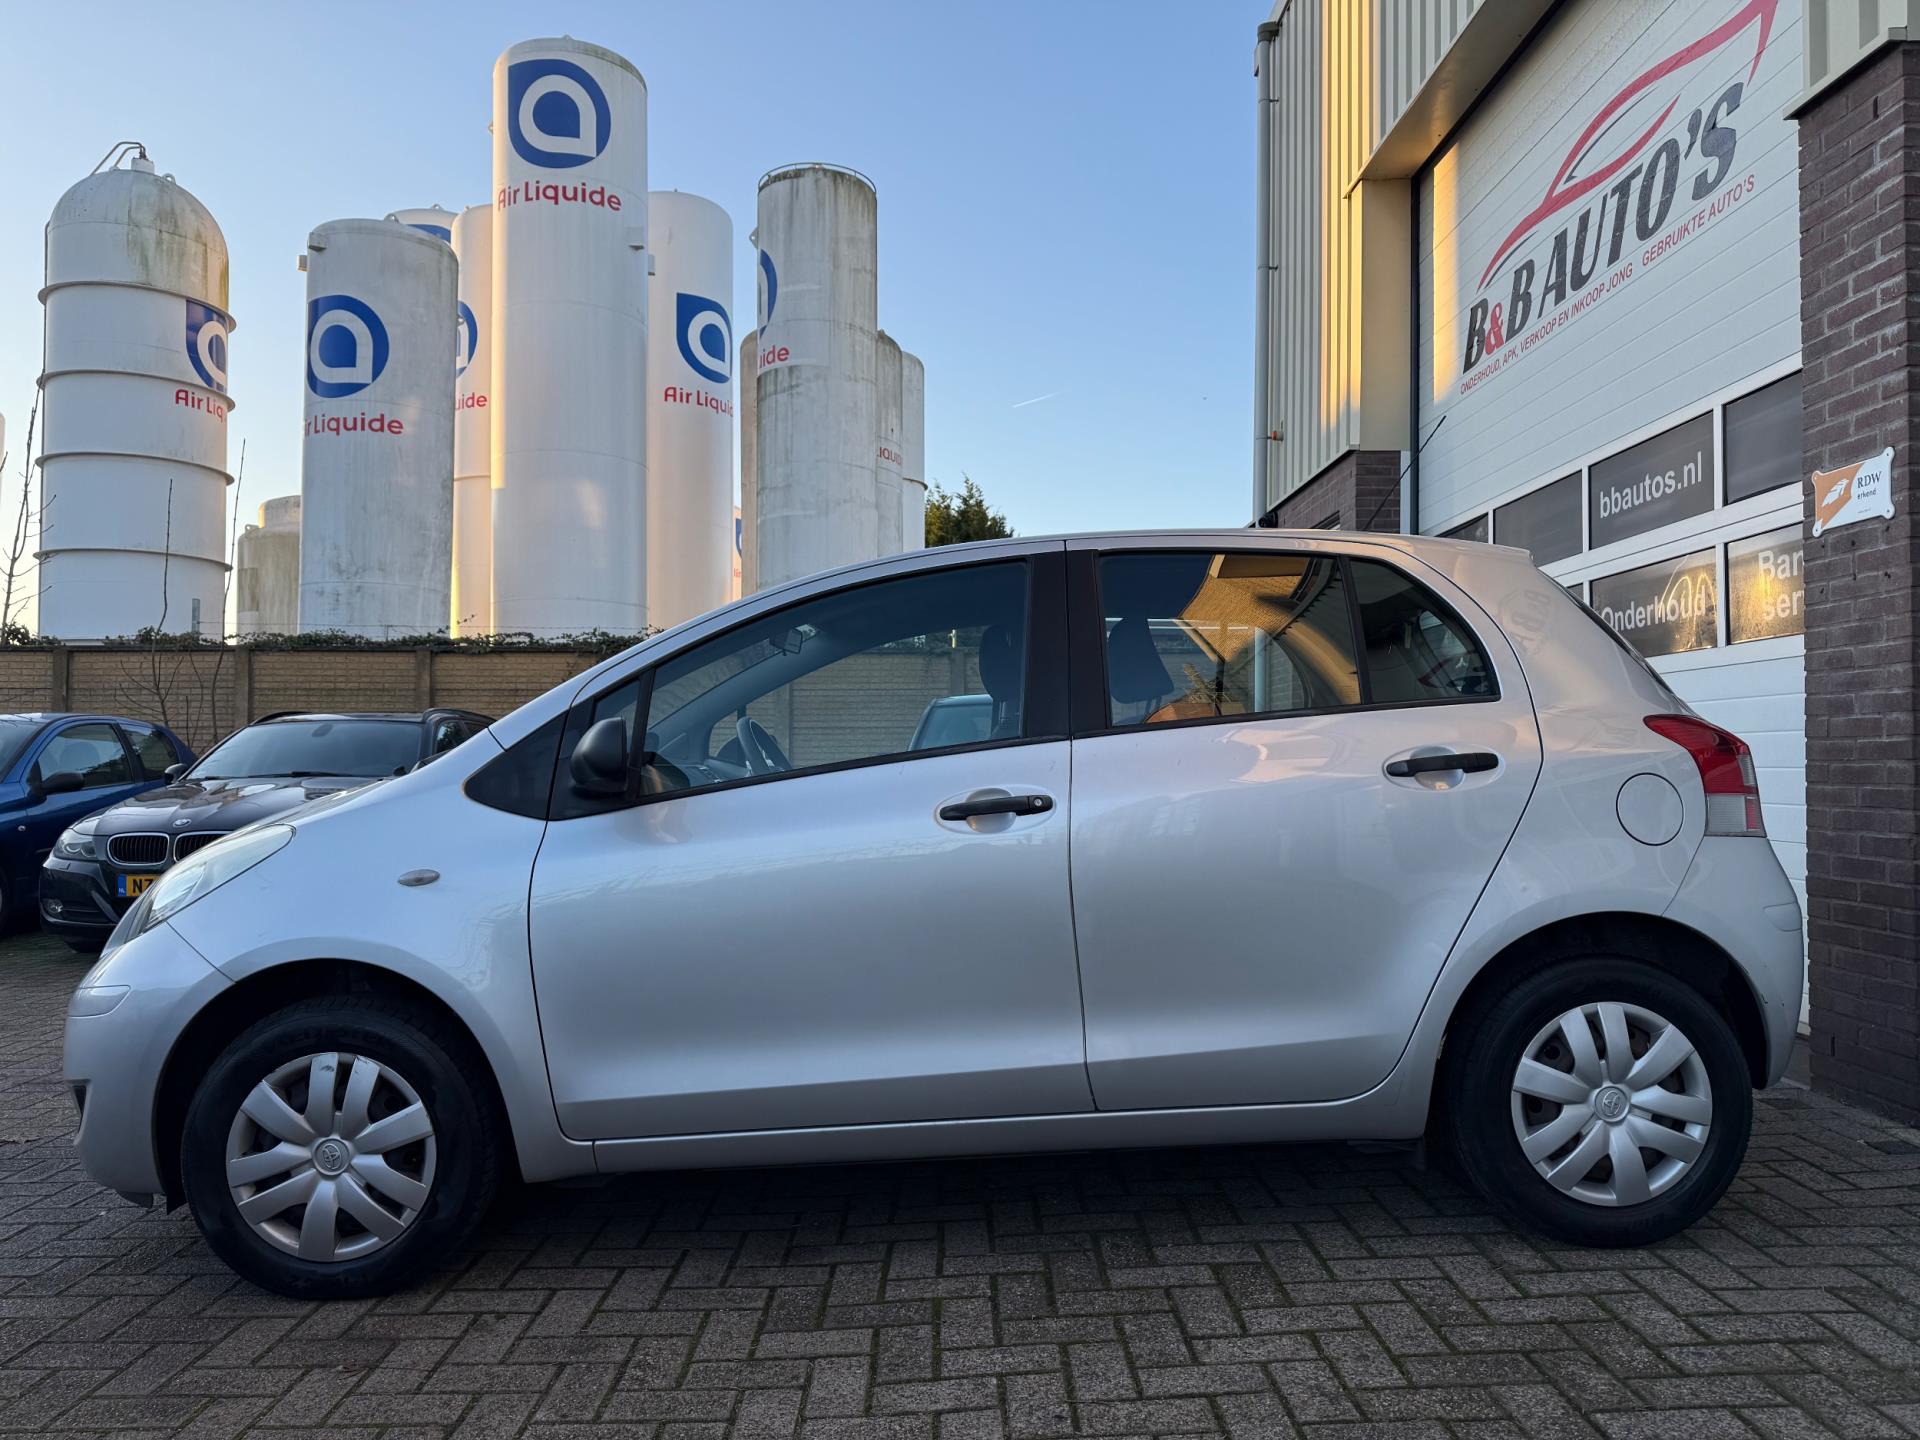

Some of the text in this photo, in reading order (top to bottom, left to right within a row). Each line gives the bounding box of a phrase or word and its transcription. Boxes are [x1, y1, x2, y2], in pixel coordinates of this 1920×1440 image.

[497, 180, 622, 212] Air Liquide
[1537, 82, 1744, 319] AUTO'S
[1520, 317, 1557, 353] VERKOOP
[1558, 307, 1570, 328] EN
[1571, 282, 1605, 317] INKOOP
[1606, 263, 1633, 293] JONG
[1642, 210, 1706, 267] GEBRUIKTE
[1707, 174, 1755, 222] AUTO'S
[175, 388, 204, 410] Air
[665, 386, 693, 404] Air
[313, 413, 404, 436] Liquide
[1600, 450, 1702, 519] bbautos.nl
[1857, 471, 1882, 489] RDW
[1601, 584, 1706, 631] Onderhoud
[1761, 589, 1804, 620] ser
